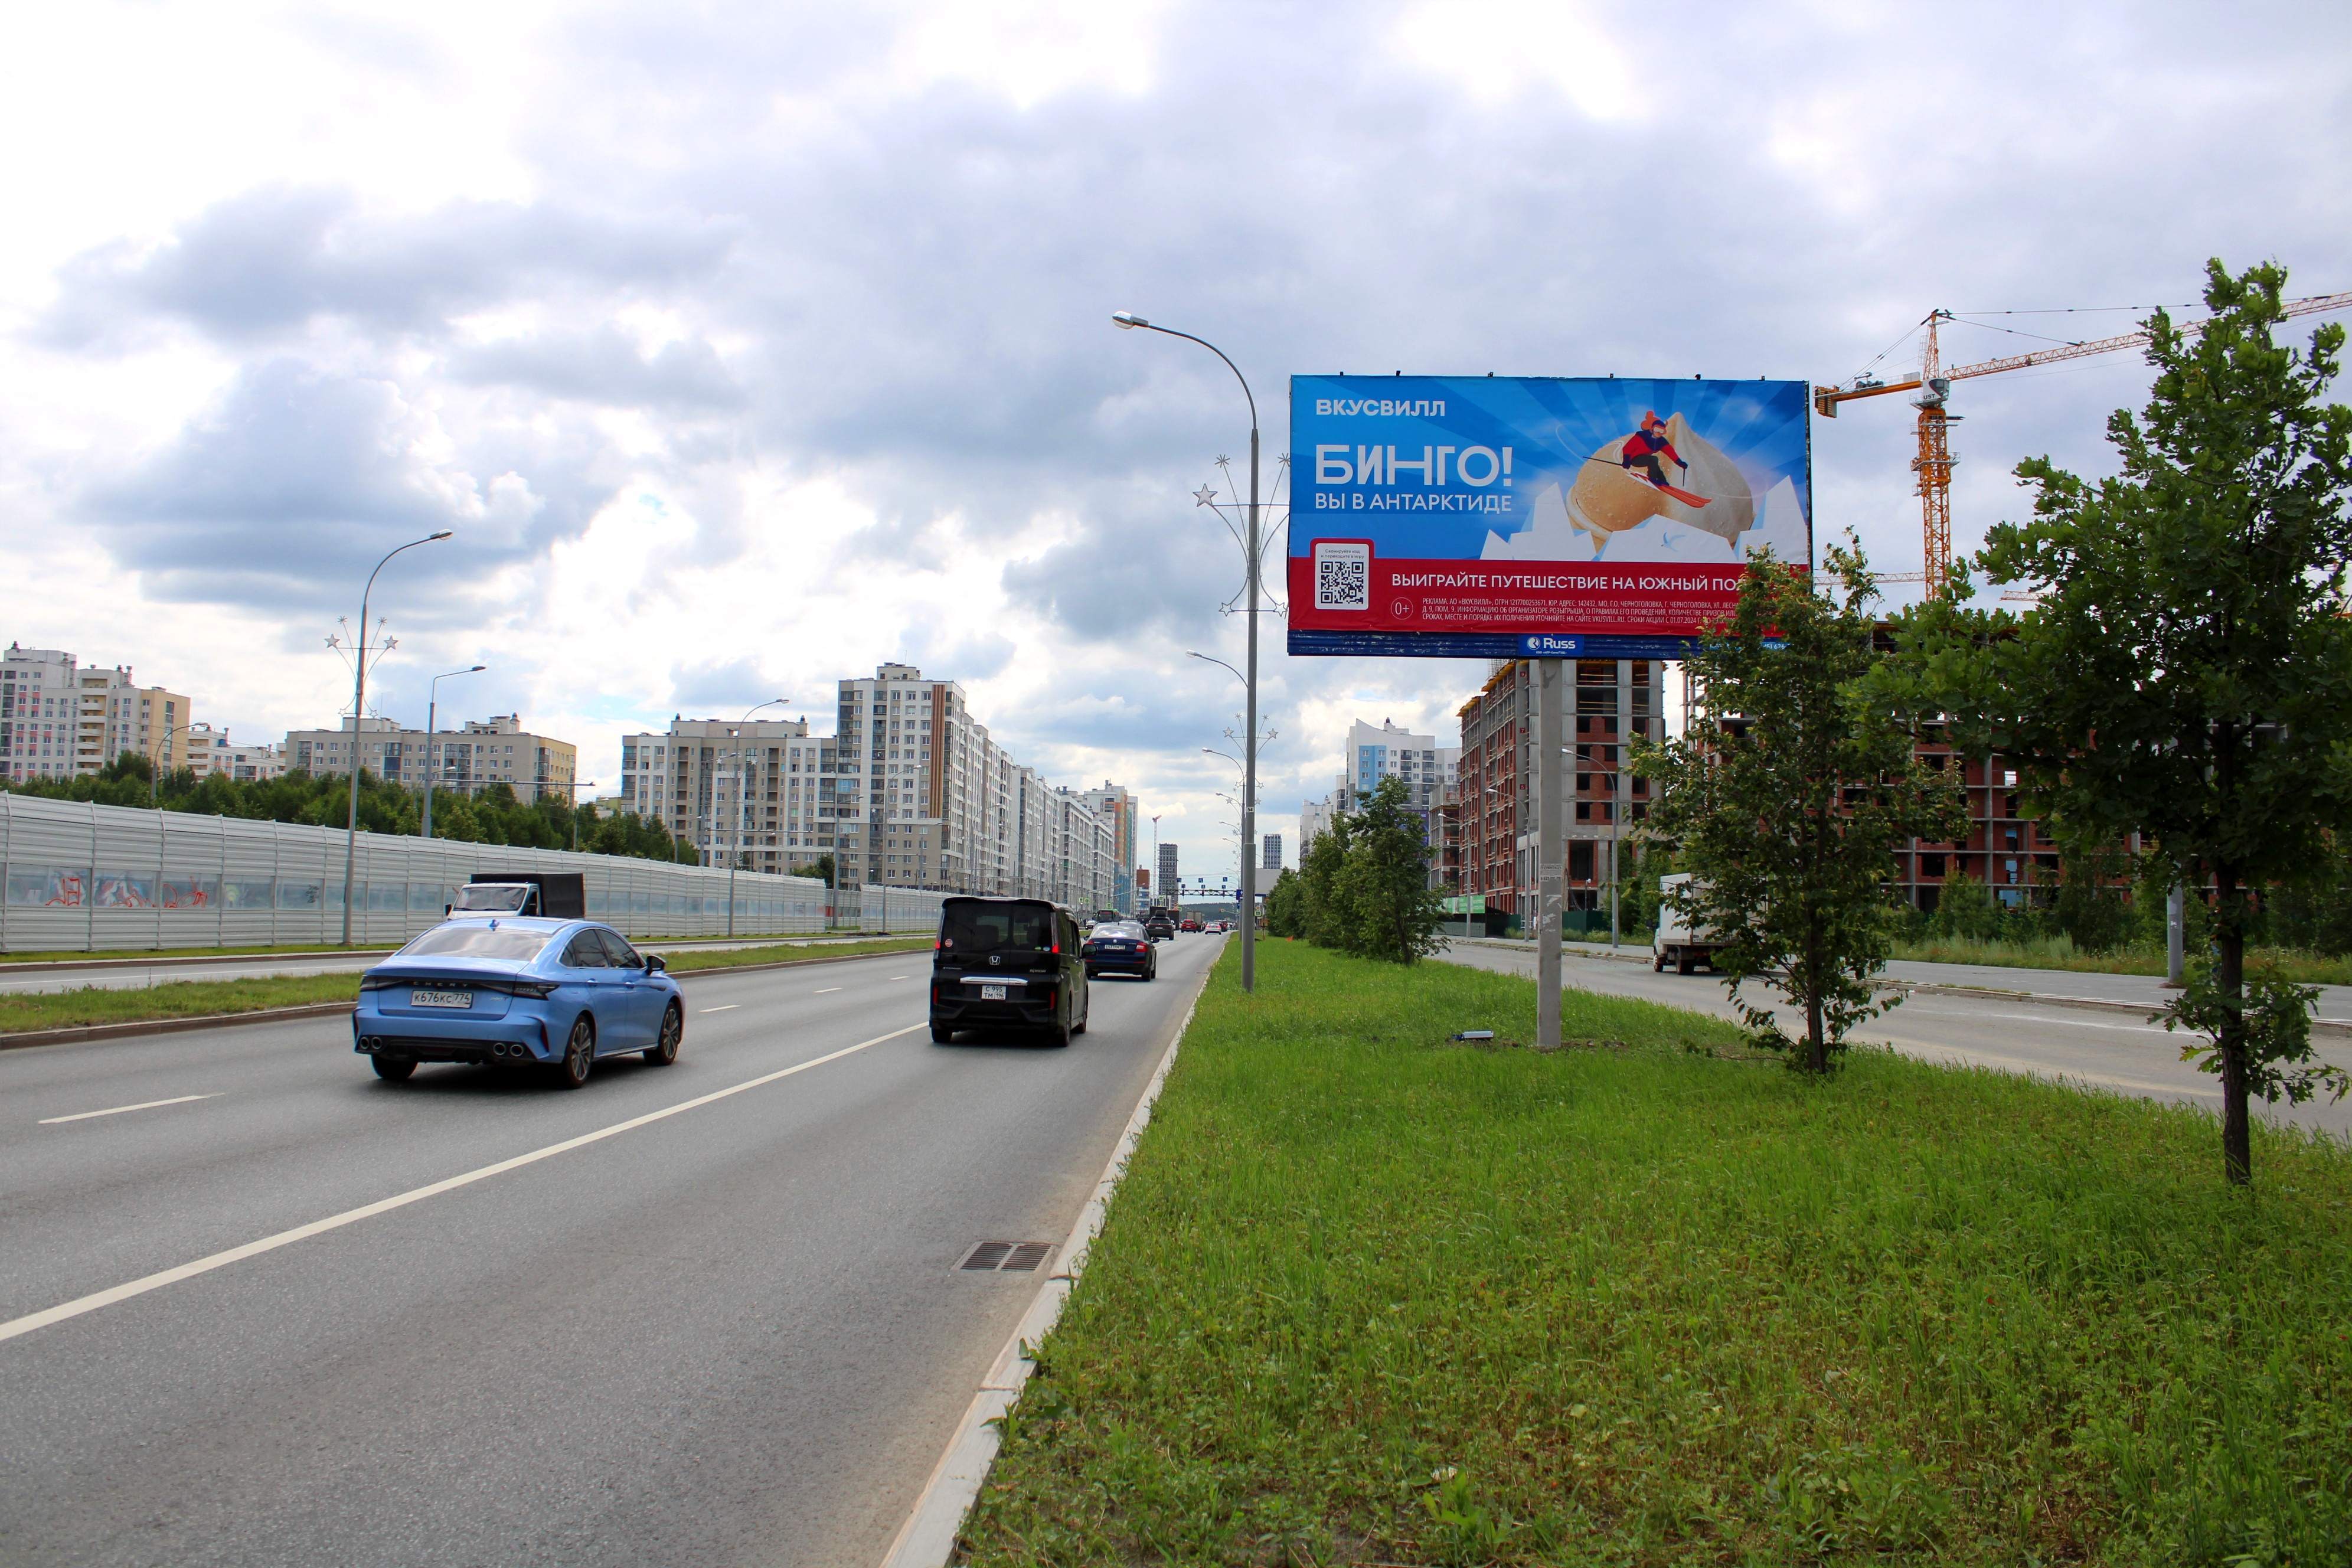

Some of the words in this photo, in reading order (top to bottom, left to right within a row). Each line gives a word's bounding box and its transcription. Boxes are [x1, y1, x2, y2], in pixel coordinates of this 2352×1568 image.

[1316, 399, 1446, 417] ВКУСВИЛЛ
[1315, 444, 1513, 487] БИНГО!
[1315, 493, 1345, 510] ВЫ
[1353, 493, 1365, 510] В
[1369, 494, 1513, 515] АНТАРКТИДЕ
[1392, 571, 1487, 587] ВЫИГРАЙТЕ
[1491, 575, 1608, 589] ПУТЕШЕСТВИЕ
[1612, 576, 1636, 590] НА
[1639, 574, 1708, 590] ЮЖНЫЙ
[1394, 602, 1410, 615] 0+
[1549, 607, 1585, 616] РОЗЫГРЫША,
[1535, 613, 1565, 622] УТОЧНЯЙТЕ
[1543, 638, 1576, 649] Russ
